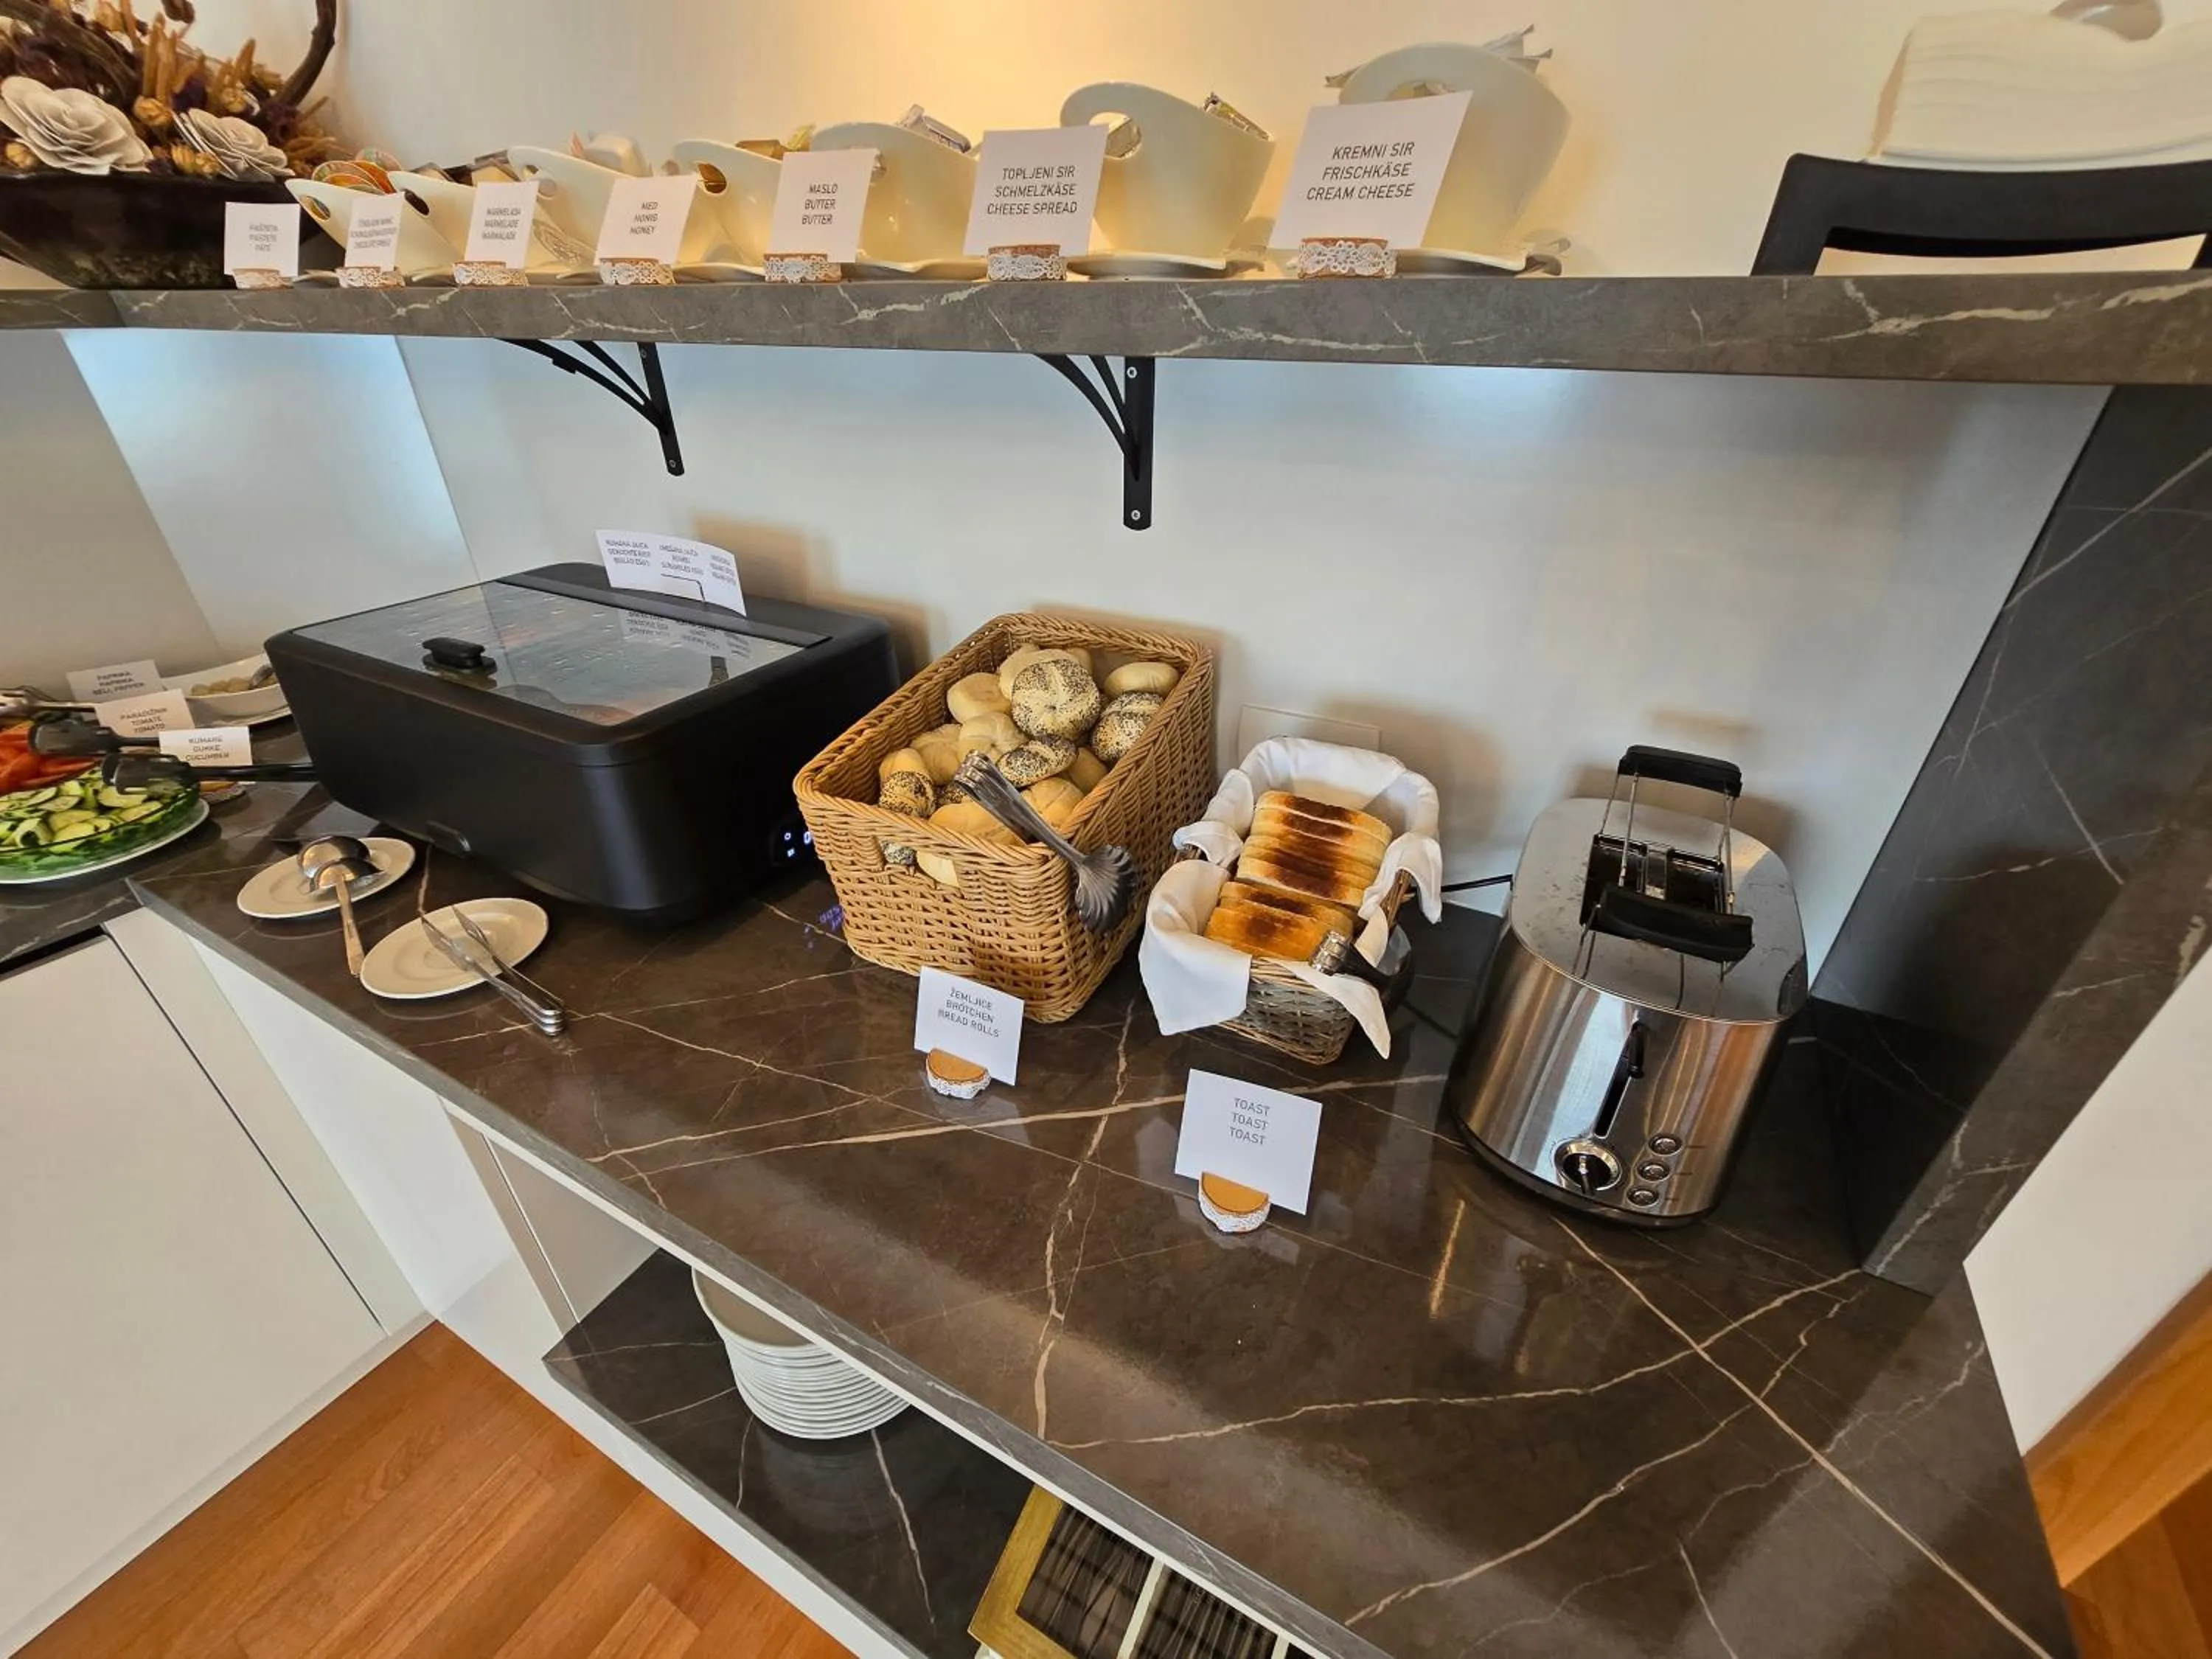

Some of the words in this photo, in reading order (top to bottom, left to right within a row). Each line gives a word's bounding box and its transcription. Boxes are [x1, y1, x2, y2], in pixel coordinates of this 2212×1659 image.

[1332, 144, 1388, 160] KREMNI
[1390, 142, 1415, 157] SIR
[1003, 167, 1055, 180] TOPLJENI
[1057, 165, 1076, 178] SIR
[1322, 161, 1412, 181] FRISCHKÄSE
[809, 184, 838, 194] MASLO
[995, 182, 1077, 198] SCHMELZKÄSE
[1307, 186, 1355, 201] CREAM
[1357, 183, 1416, 200] CHEESE
[641, 201, 658, 210] MED
[804, 198, 836, 210] BUTTER
[987, 203, 1030, 215] CHEESE
[1032, 201, 1077, 215] SPREAD
[801, 215, 833, 225] BUTTER
[950, 986, 994, 1010] ŽEMLJICE
[946, 999, 995, 1023] BRÖTCHEN
[937, 1009, 968, 1026] BREAD
[970, 1020, 1001, 1037] ROLLS
[1234, 1097, 1270, 1116] TOAST
[1231, 1112, 1269, 1130] TOAST
[1229, 1127, 1267, 1145] TOAST
